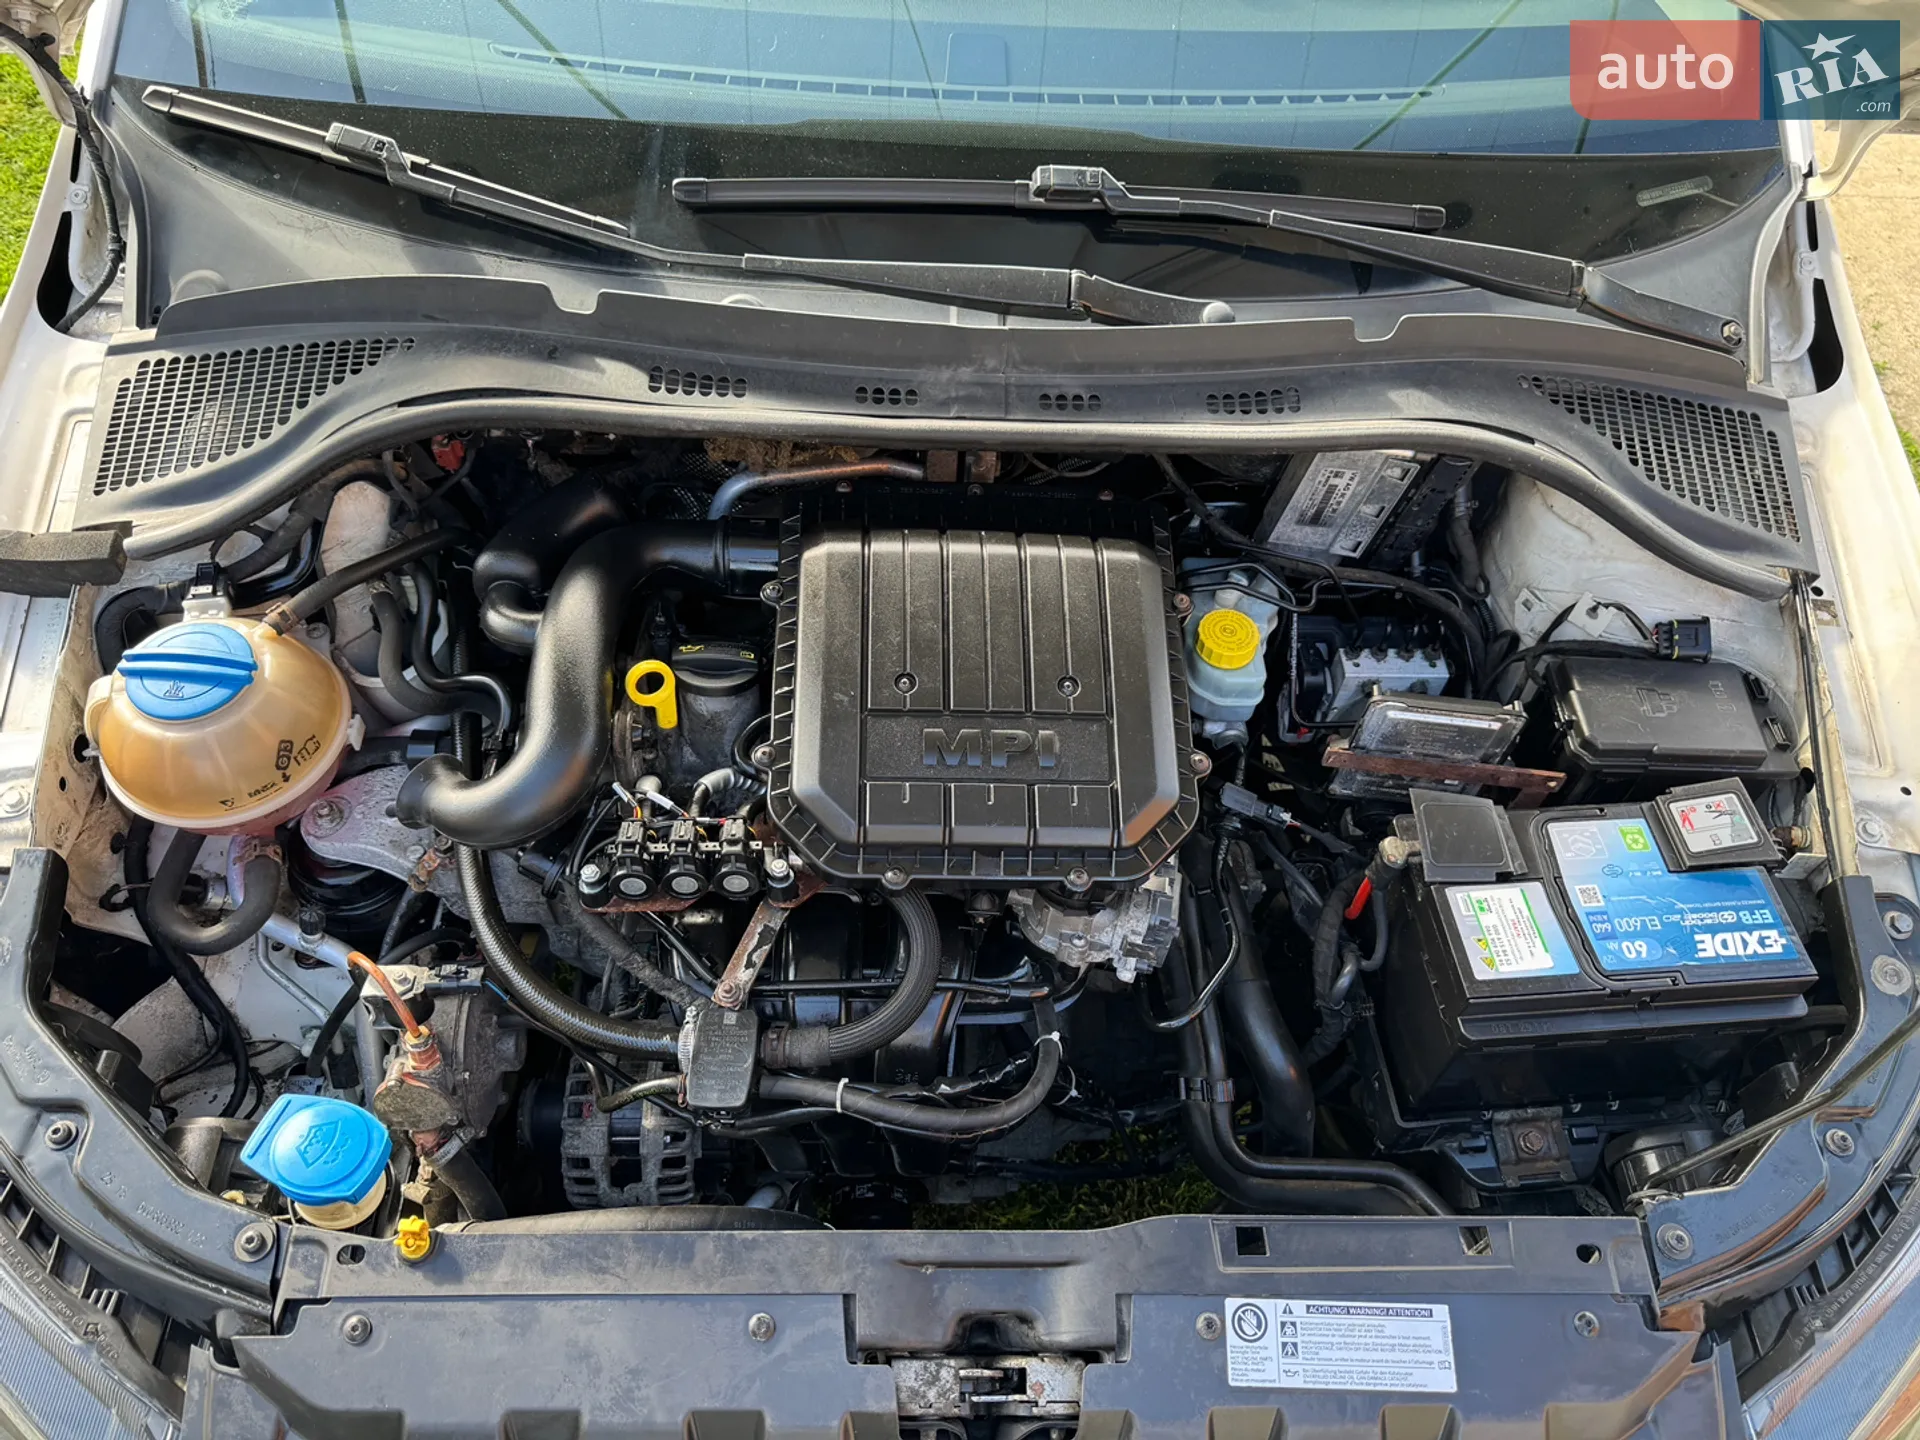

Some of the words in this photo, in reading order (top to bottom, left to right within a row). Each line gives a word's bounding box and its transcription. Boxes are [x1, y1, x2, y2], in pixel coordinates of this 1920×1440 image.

[278, 742, 291, 767] G13
[923, 728, 1057, 767] MPI
[1614, 916, 1662, 932] EL600
[1739, 909, 1775, 924] EFB
[1592, 921, 1612, 934] 640
[1622, 941, 1647, 959] 60
[1694, 930, 1788, 959] EXIDE
[1308, 1305, 1347, 1314] ACHTUNG!
[1349, 1306, 1387, 1316] WARNING!
[1388, 1308, 1431, 1317] ATTENTION!
